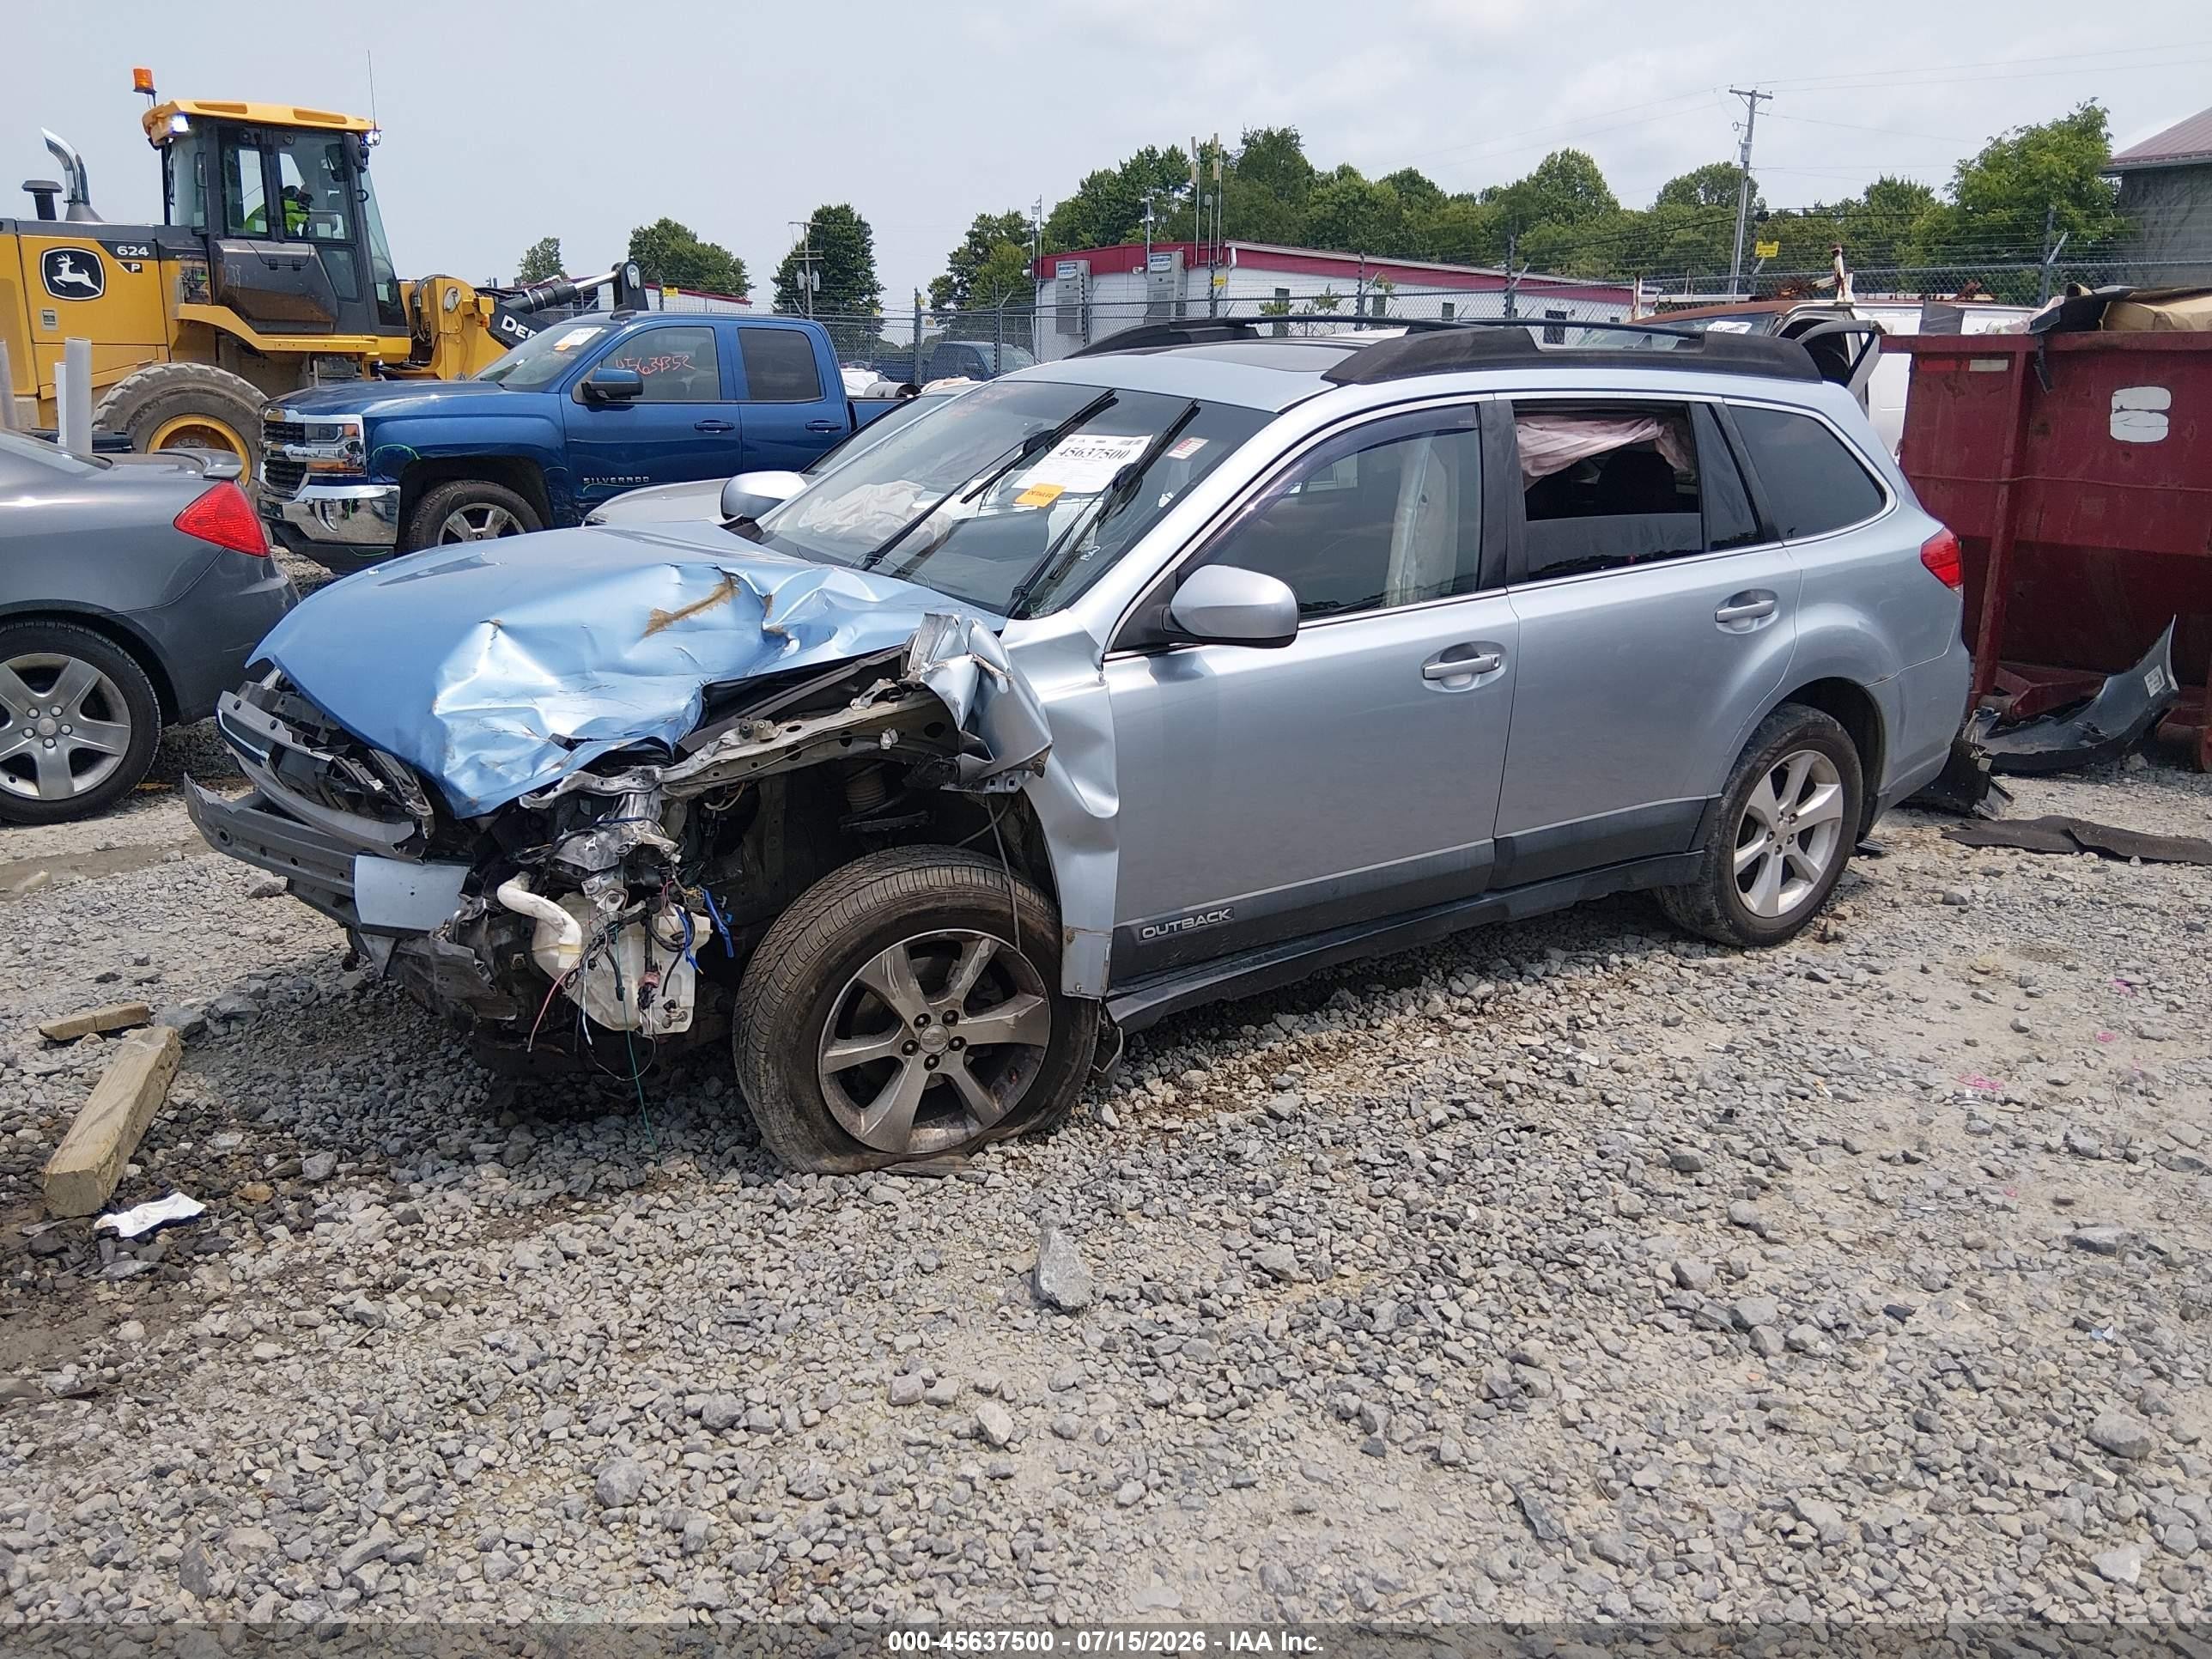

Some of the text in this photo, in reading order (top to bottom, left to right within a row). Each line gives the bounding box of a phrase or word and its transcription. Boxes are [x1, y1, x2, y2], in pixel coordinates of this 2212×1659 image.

[117, 246, 149, 257] 624
[131, 263, 141, 272] P
[1057, 447, 1132, 459] 45637500
[583, 476, 650, 484] SILVERADO
[1141, 908, 1231, 939] OUTBACK
